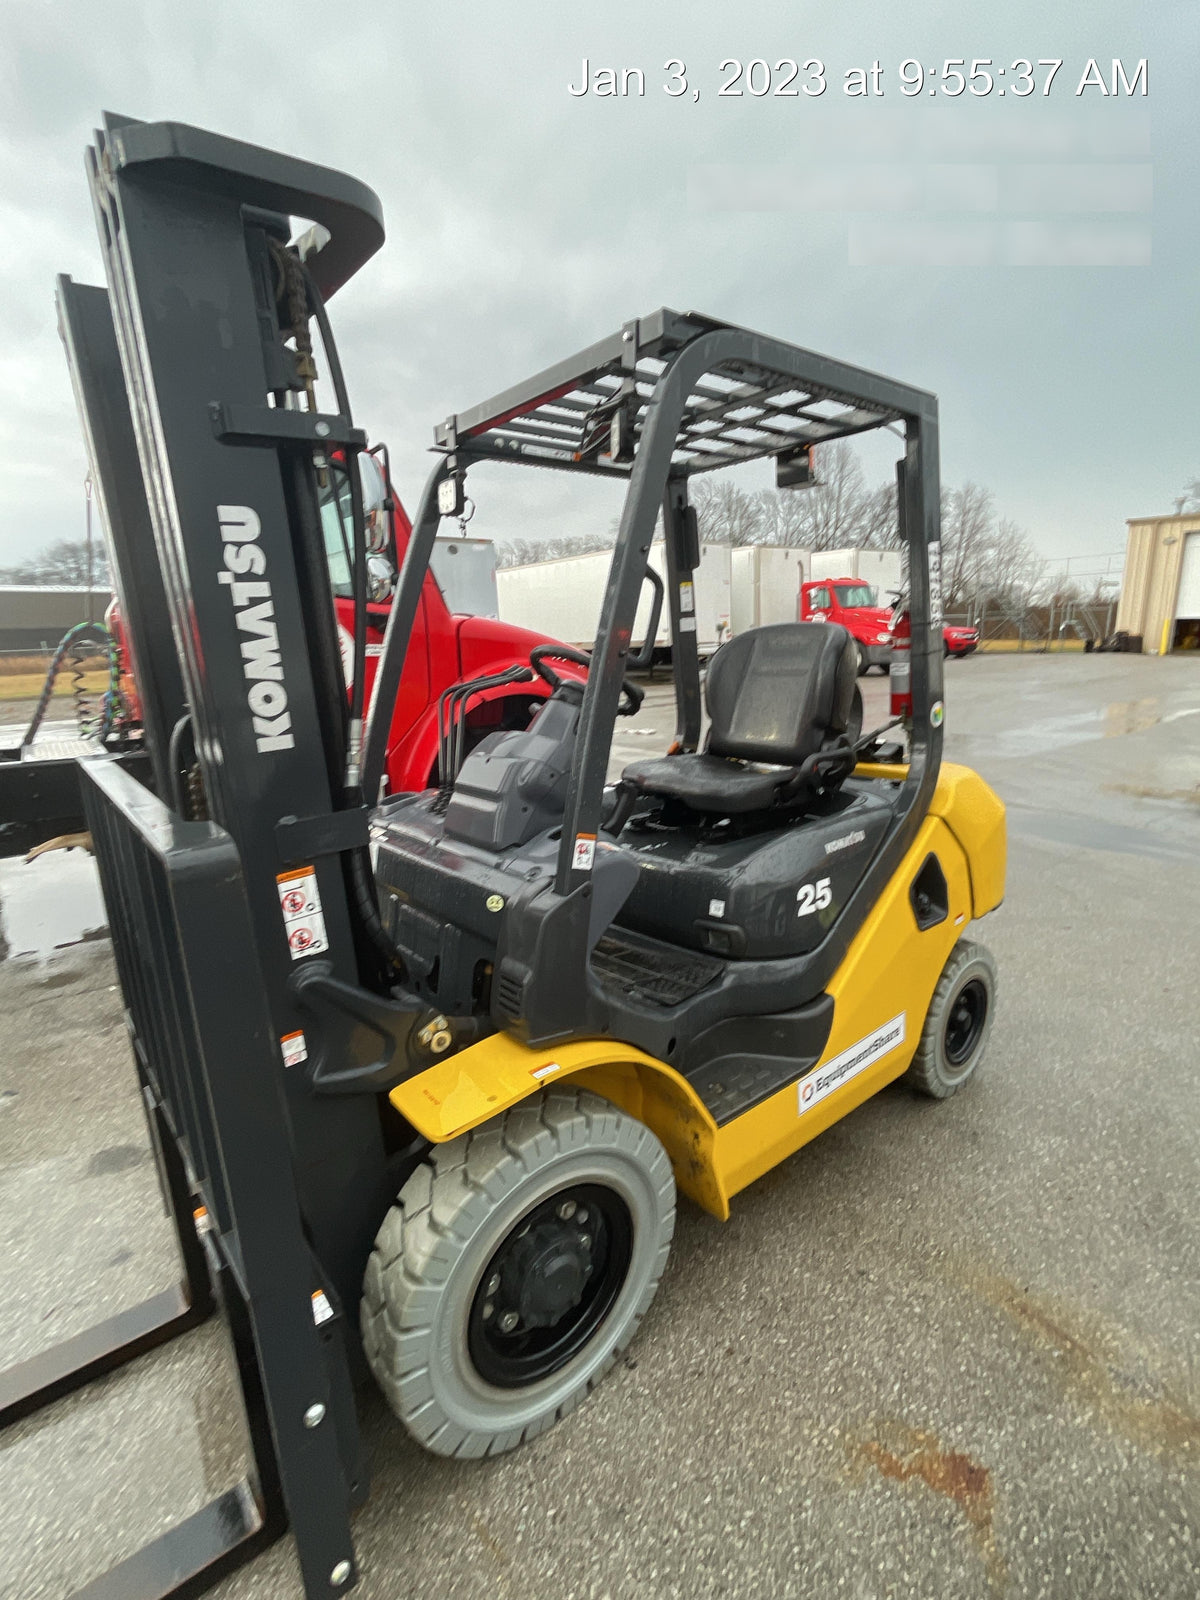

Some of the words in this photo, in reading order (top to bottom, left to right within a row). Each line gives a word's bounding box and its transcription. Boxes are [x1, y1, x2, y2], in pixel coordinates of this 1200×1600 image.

[217, 504, 295, 753] KOMATSU
[796, 876, 832, 917] 25
[815, 1026, 901, 1092] EquipmentShare
